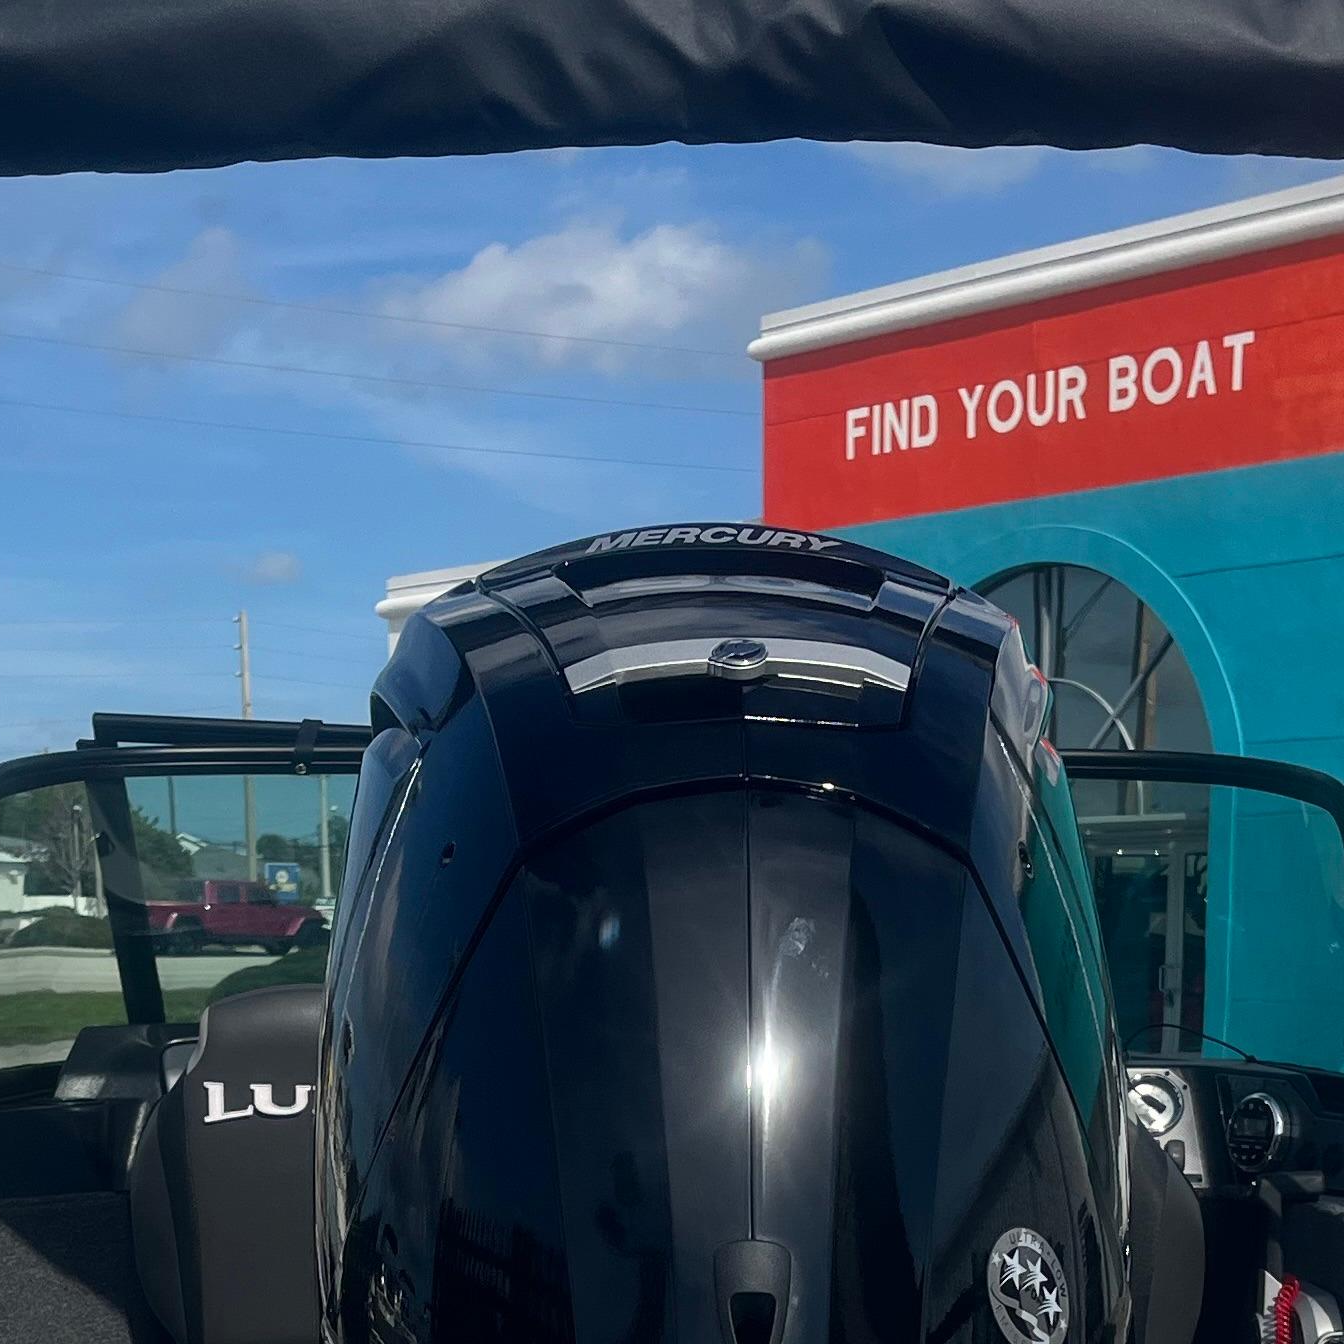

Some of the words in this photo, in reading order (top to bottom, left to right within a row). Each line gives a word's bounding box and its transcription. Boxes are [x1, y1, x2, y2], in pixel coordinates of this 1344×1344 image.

[845, 394, 939, 461] FIND
[958, 364, 1088, 439] YOUR
[1108, 330, 1256, 414] BOAT
[584, 526, 845, 554] MERCURY
[203, 1081, 316, 1123] LU
